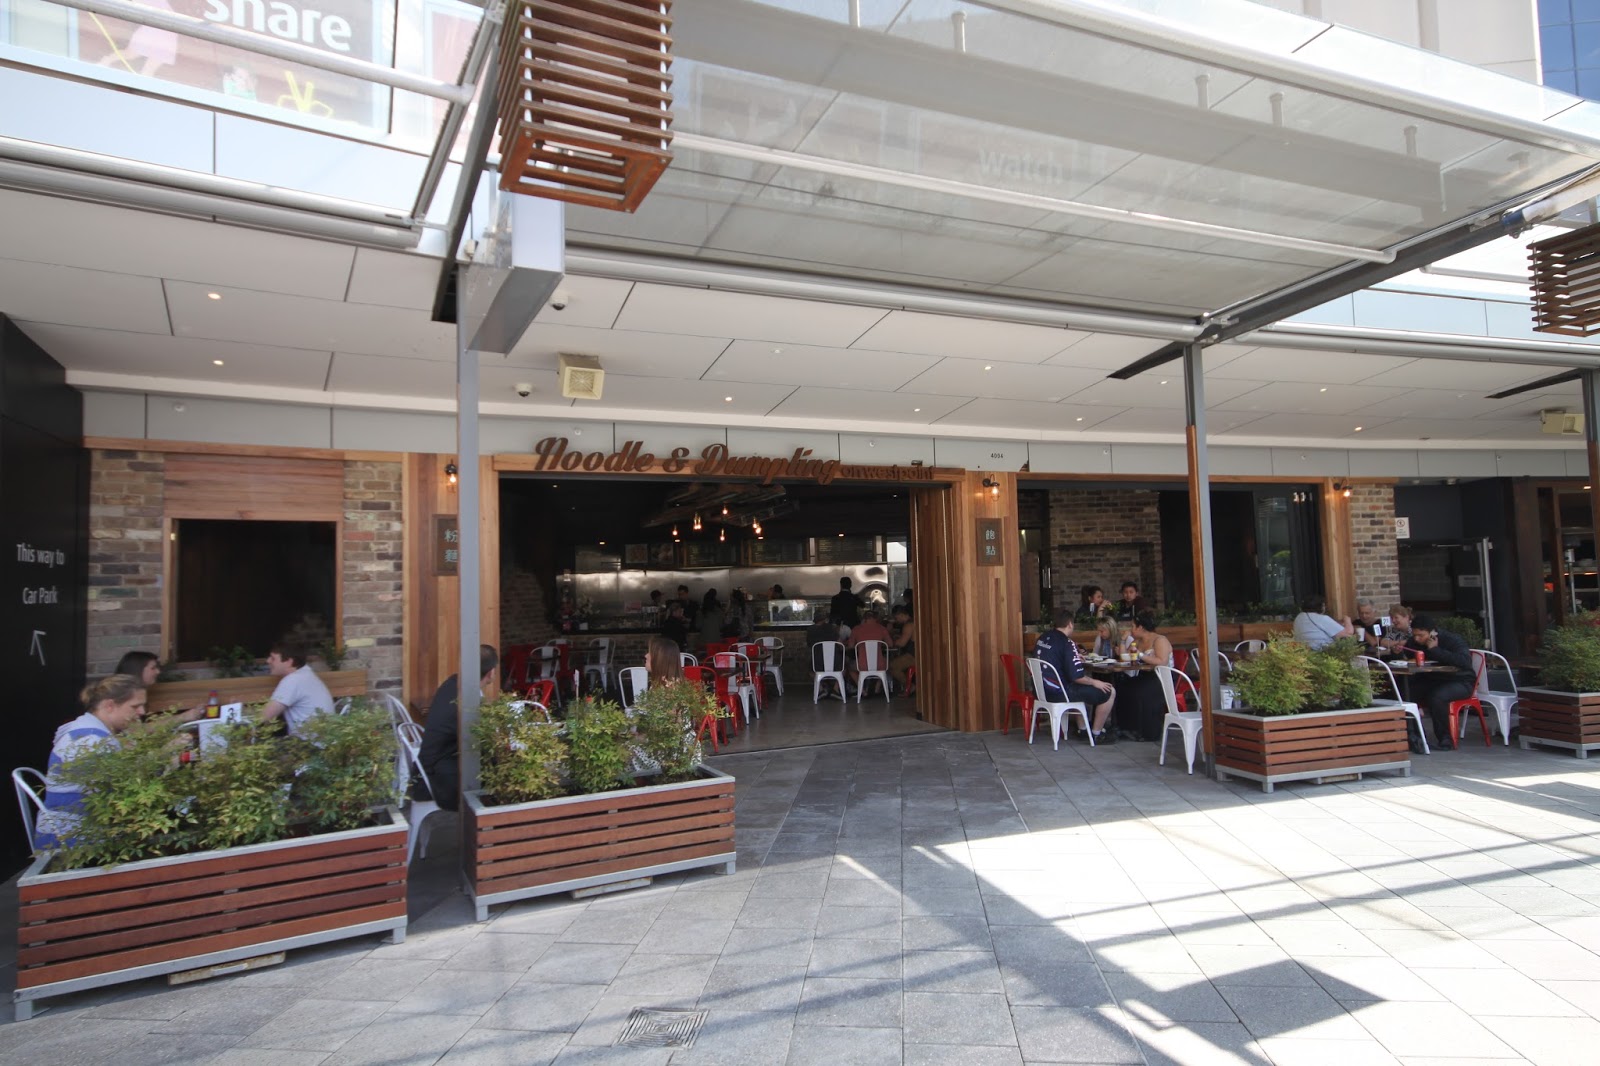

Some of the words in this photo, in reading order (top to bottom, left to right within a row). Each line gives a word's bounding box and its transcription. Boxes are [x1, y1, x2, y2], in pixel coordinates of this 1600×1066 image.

[534, 437, 655, 472] Noodle
[662, 447, 690, 473] &
[695, 443, 842, 485] Dumpling
[16, 542, 35, 562] This
[37, 549, 55, 568] way
[56, 549, 65, 565] to
[22, 587, 38, 604] Car
[39, 585, 58, 604] Park
